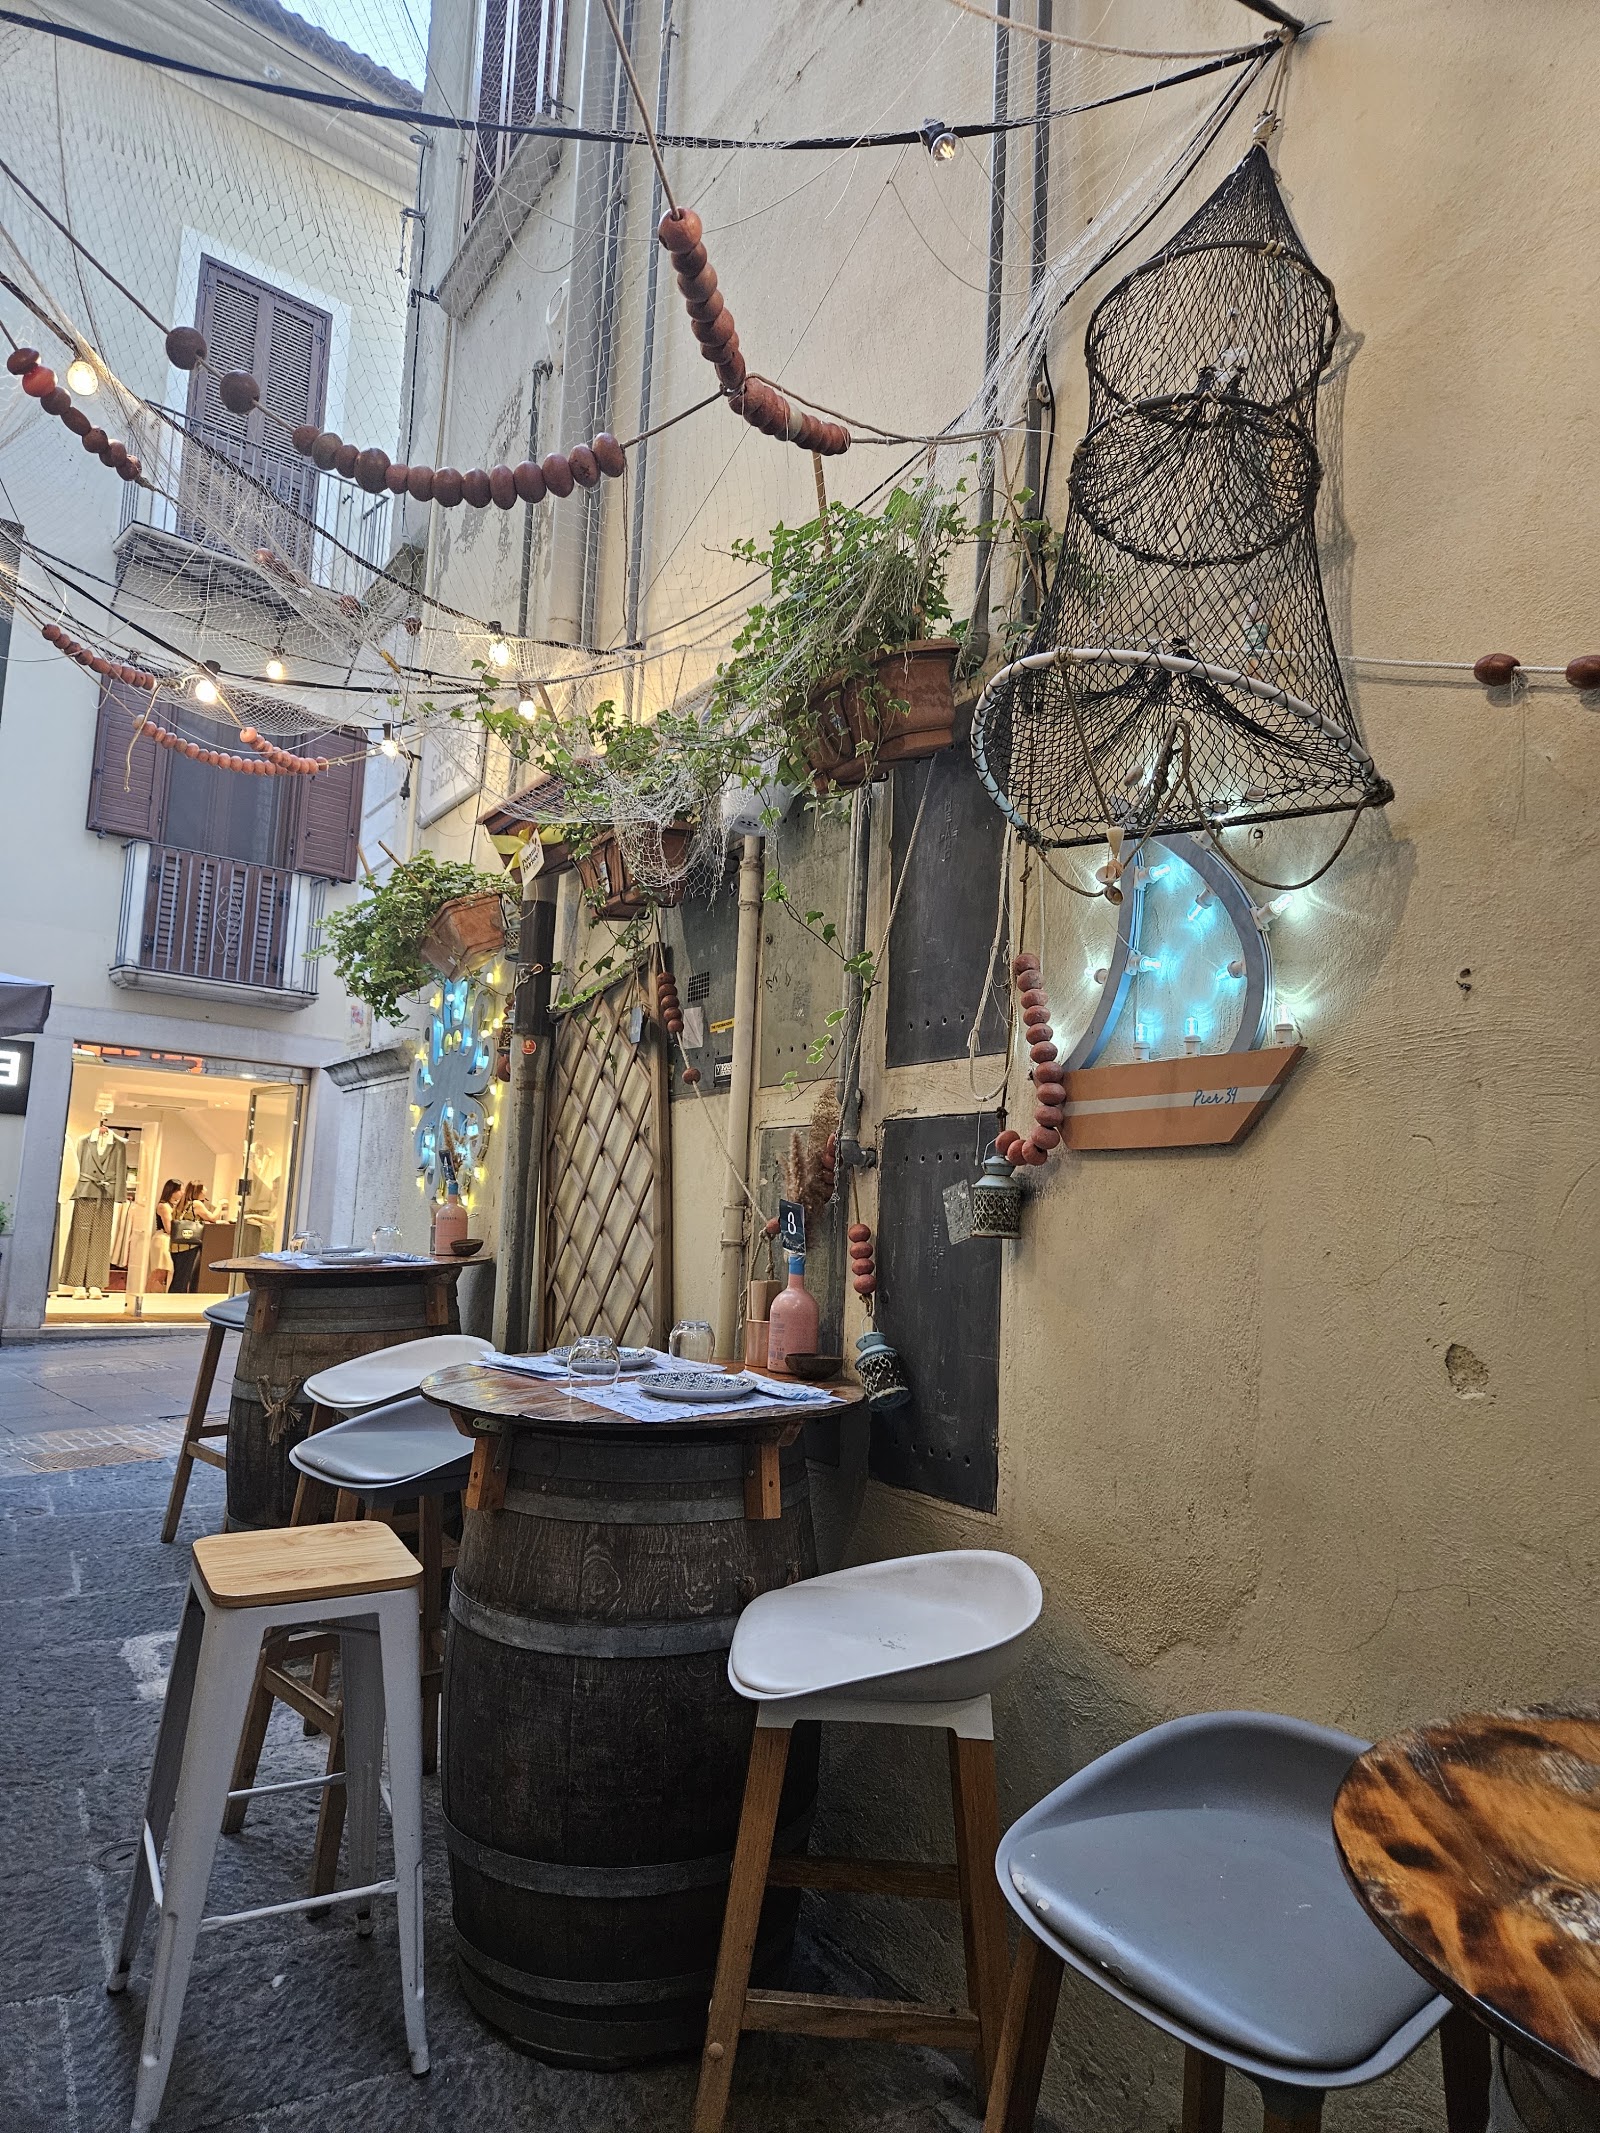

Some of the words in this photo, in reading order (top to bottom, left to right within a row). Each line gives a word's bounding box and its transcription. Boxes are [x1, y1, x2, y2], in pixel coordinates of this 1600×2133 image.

[1193, 1089, 1224, 1107] Pier
[1225, 1087, 1238, 1104] 39
[787, 1211, 796, 1235] 8
